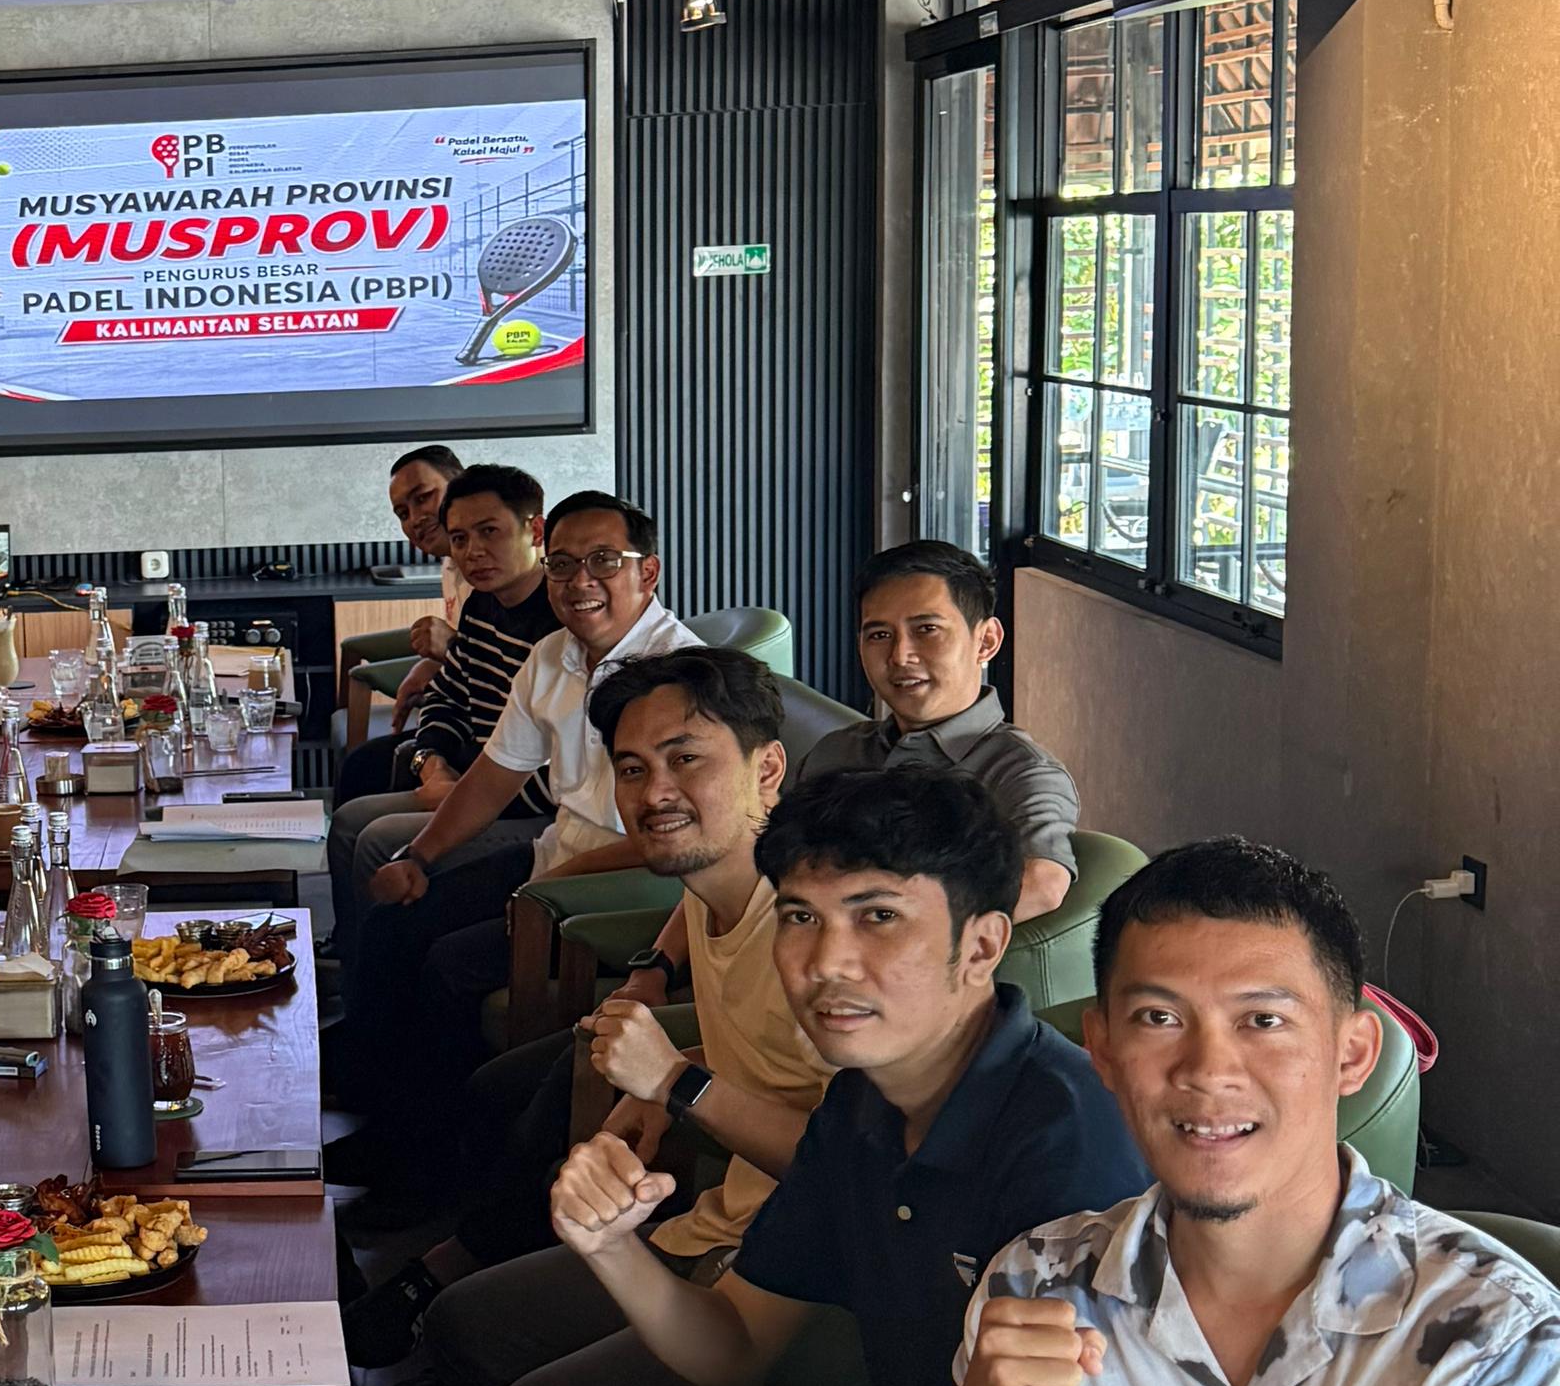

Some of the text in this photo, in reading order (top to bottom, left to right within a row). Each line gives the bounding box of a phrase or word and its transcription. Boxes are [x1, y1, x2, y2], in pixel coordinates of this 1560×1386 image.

[183, 134, 225, 155] PB
[448, 136, 480, 146] Padel
[184, 157, 214, 178] PI
[19, 177, 453, 218] MUSYAWARAH PROVINSI
[11, 204, 449, 268] (MUSPROV)
[144, 263, 319, 283] PENGURUS BESAR
[23, 272, 453, 314] PADEL INDONESIA (PBPI)
[96, 313, 359, 338] KALIMANTAN SELATAN
